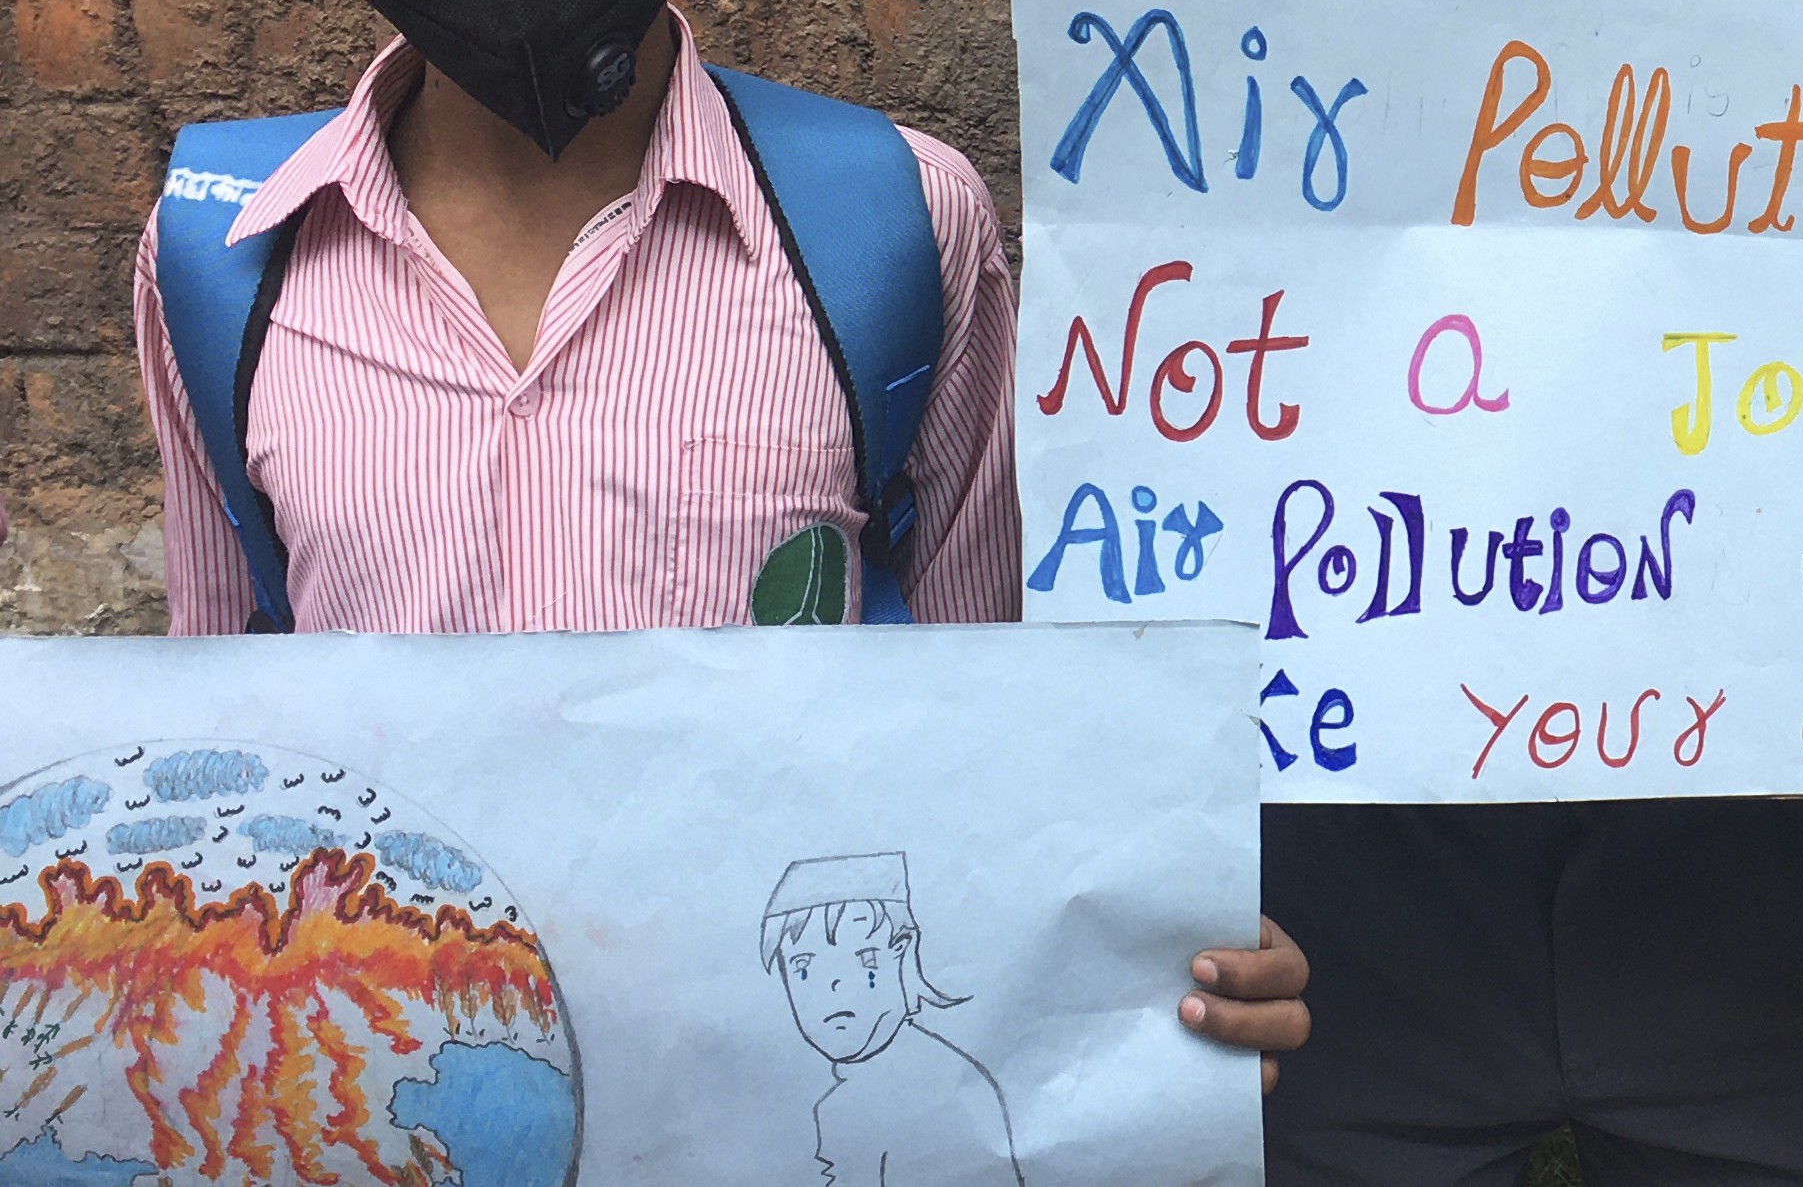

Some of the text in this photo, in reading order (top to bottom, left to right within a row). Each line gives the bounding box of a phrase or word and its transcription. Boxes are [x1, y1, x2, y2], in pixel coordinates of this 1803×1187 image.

[1049, 7, 1369, 213] Air
[1036, 261, 1309, 442] Not
[1408, 314, 1509, 415] a
[1025, 481, 1225, 605] Air
